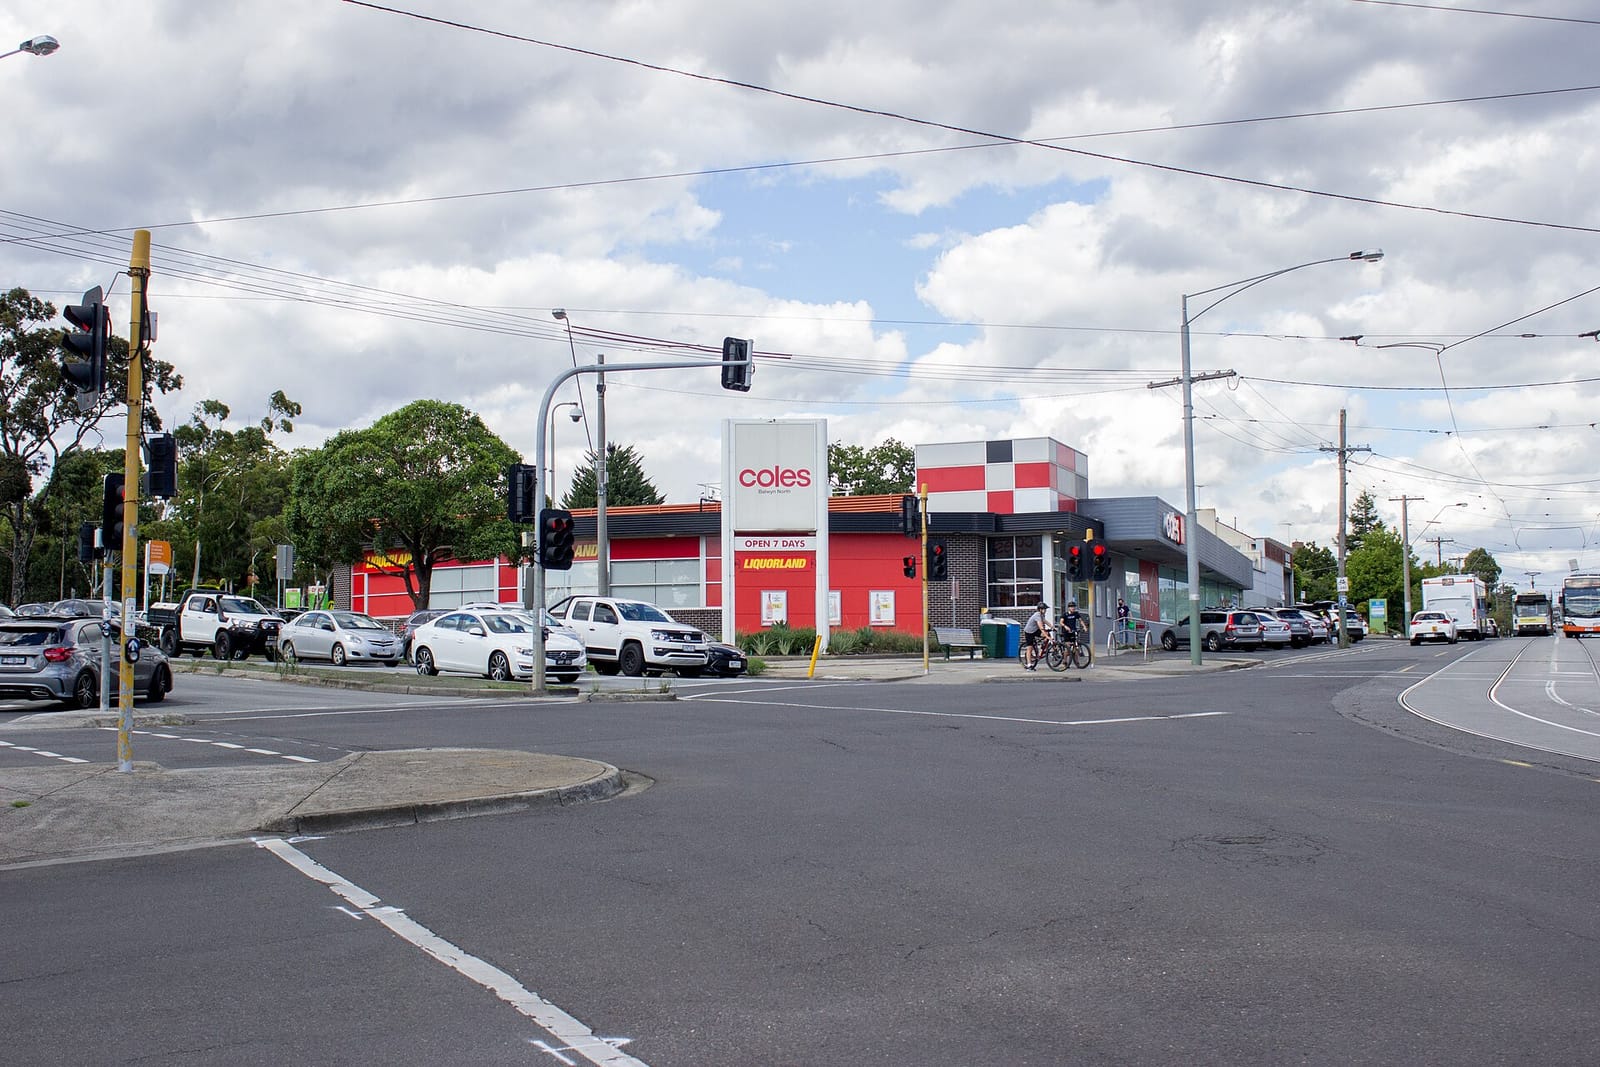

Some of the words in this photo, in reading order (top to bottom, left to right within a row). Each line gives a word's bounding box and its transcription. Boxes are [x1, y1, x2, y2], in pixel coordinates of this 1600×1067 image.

[739, 465, 811, 488] coles
[744, 540, 771, 548] OPEN
[773, 540, 779, 548] 7
[781, 540, 806, 548] DAYS
[743, 558, 807, 570] LIQUORLAND
